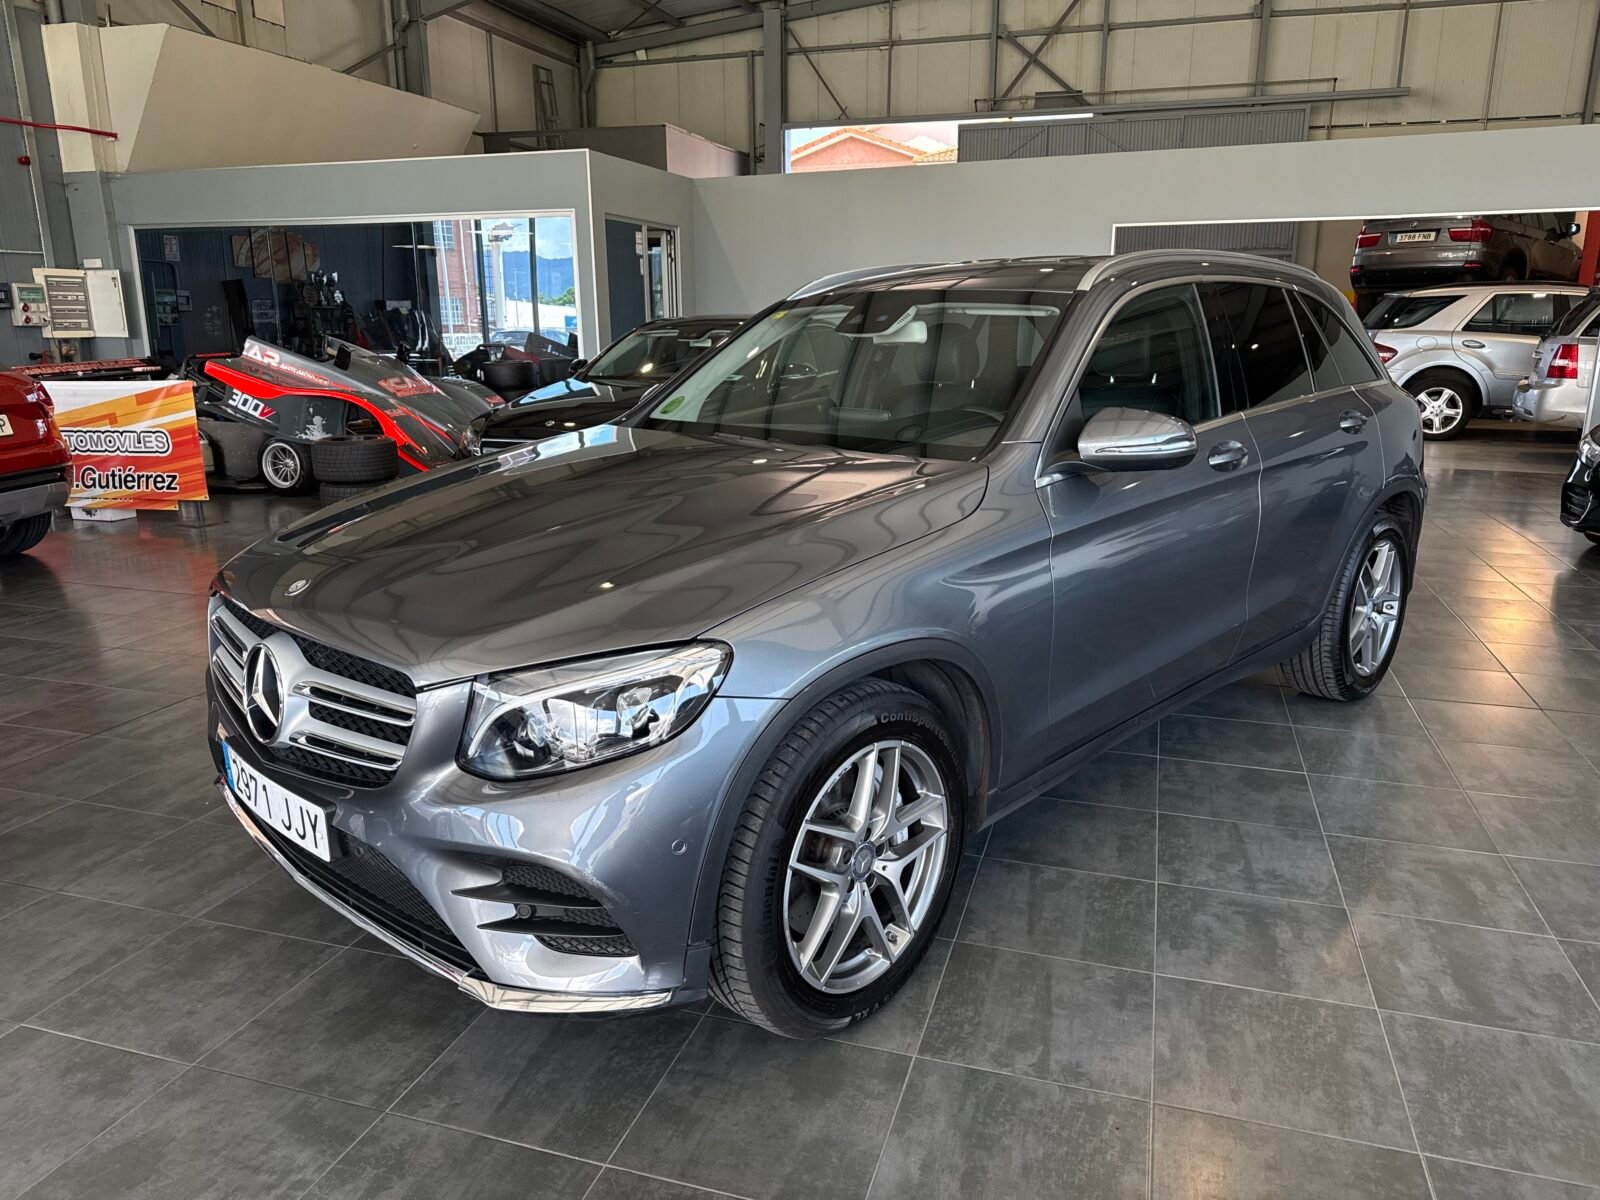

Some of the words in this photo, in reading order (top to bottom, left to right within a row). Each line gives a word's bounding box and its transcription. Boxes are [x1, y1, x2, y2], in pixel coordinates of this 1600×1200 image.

[227, 388, 277, 420] 300V
[64, 433, 167, 450] TOMOVILES
[75, 466, 179, 491] .Gutiérrez
[232, 758, 272, 820] 2971
[281, 796, 319, 850] JJY
